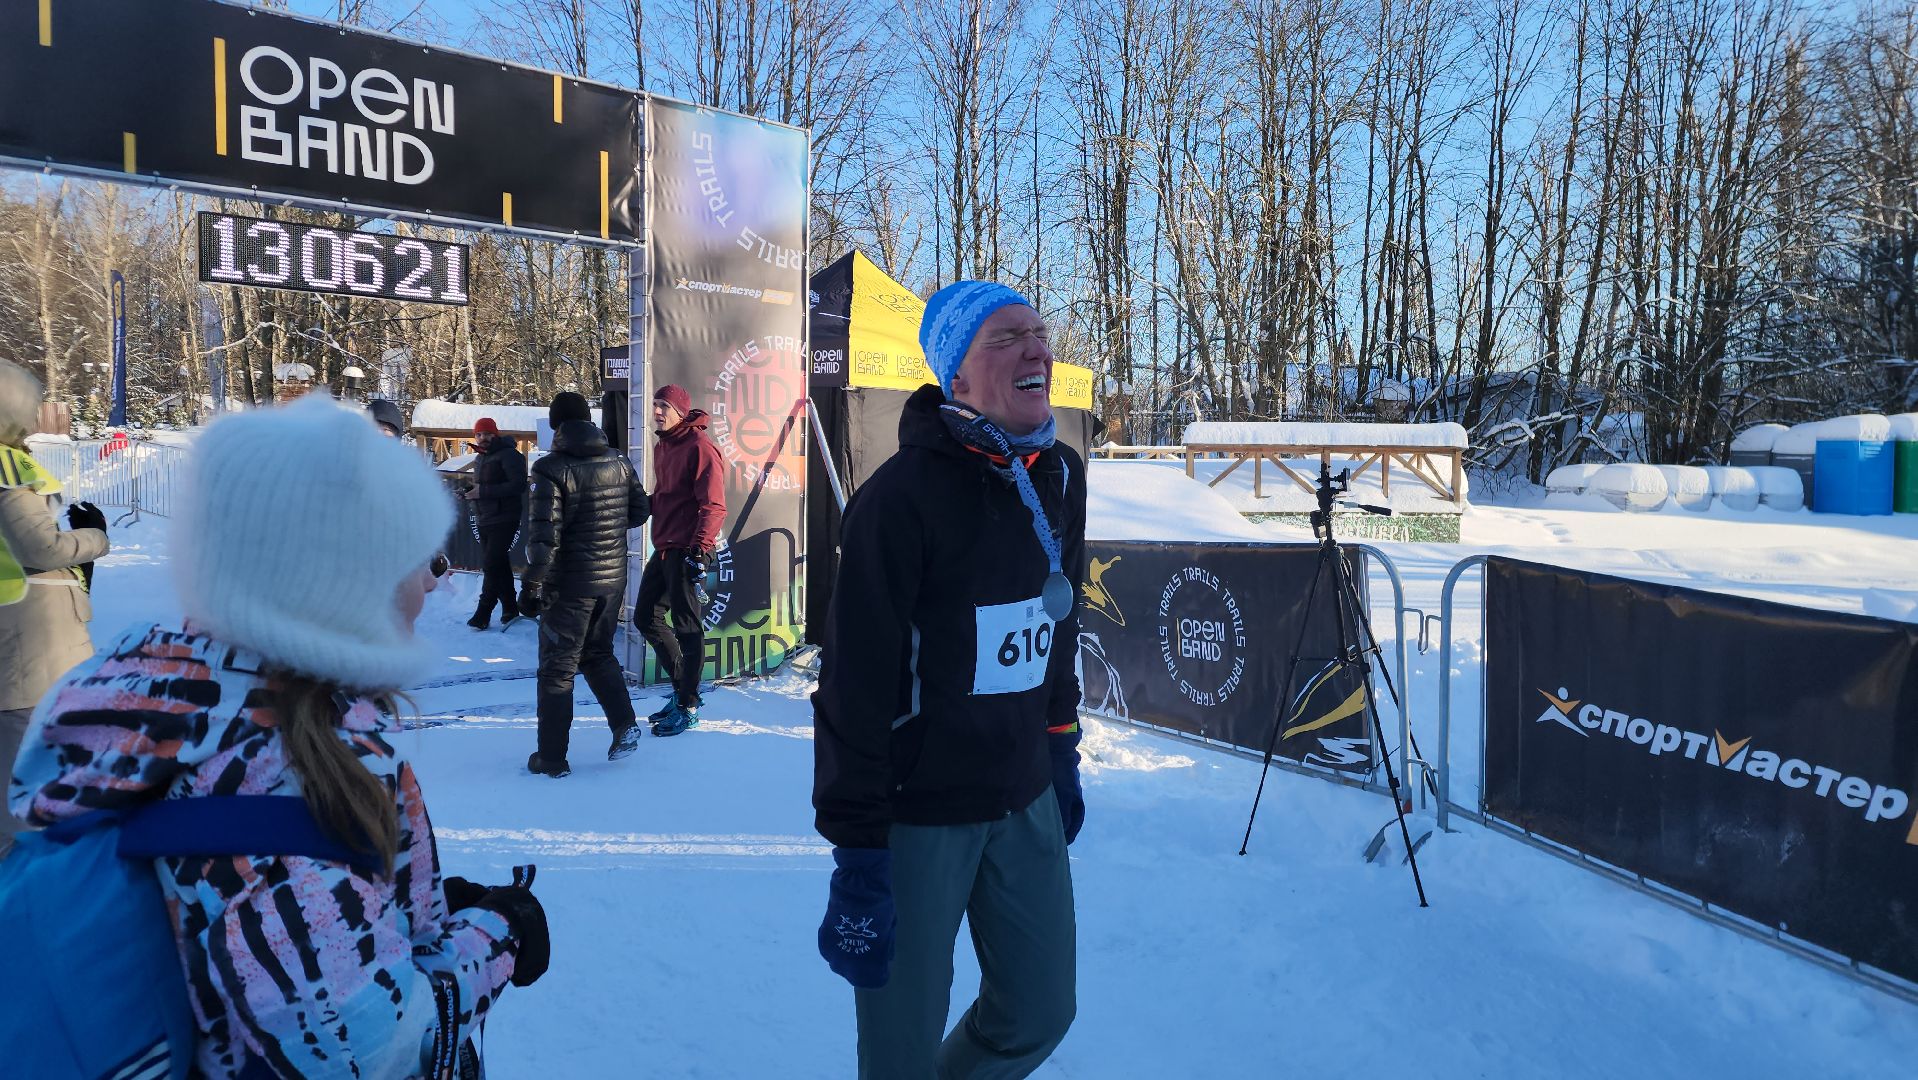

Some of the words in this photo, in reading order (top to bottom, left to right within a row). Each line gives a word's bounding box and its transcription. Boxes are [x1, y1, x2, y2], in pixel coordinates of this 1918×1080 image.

[241, 105, 435, 185] BAND
[692, 131, 735, 229] TRAILS
[736, 226, 803, 271] RAILS
[714, 340, 760, 392] TRAILS
[764, 335, 807, 357] TRAIL
[813, 362, 840, 374] BAND
[857, 362, 886, 376] BAND
[713, 402, 742, 468] TRAILS
[714, 528, 734, 582] AILS
[1159, 573, 1182, 617] TRAILS
[1182, 566, 1220, 592] TRAILS
[702, 592, 732, 632] TRAI
[1222, 588, 1246, 648] TRAILS
[997, 622, 1051, 667] 610
[1159, 625, 1178, 681] TRAILS
[1181, 638, 1221, 662] BAND
[1180, 679, 1216, 707] TRAILS
[1217, 656, 1245, 703] TRAILS
